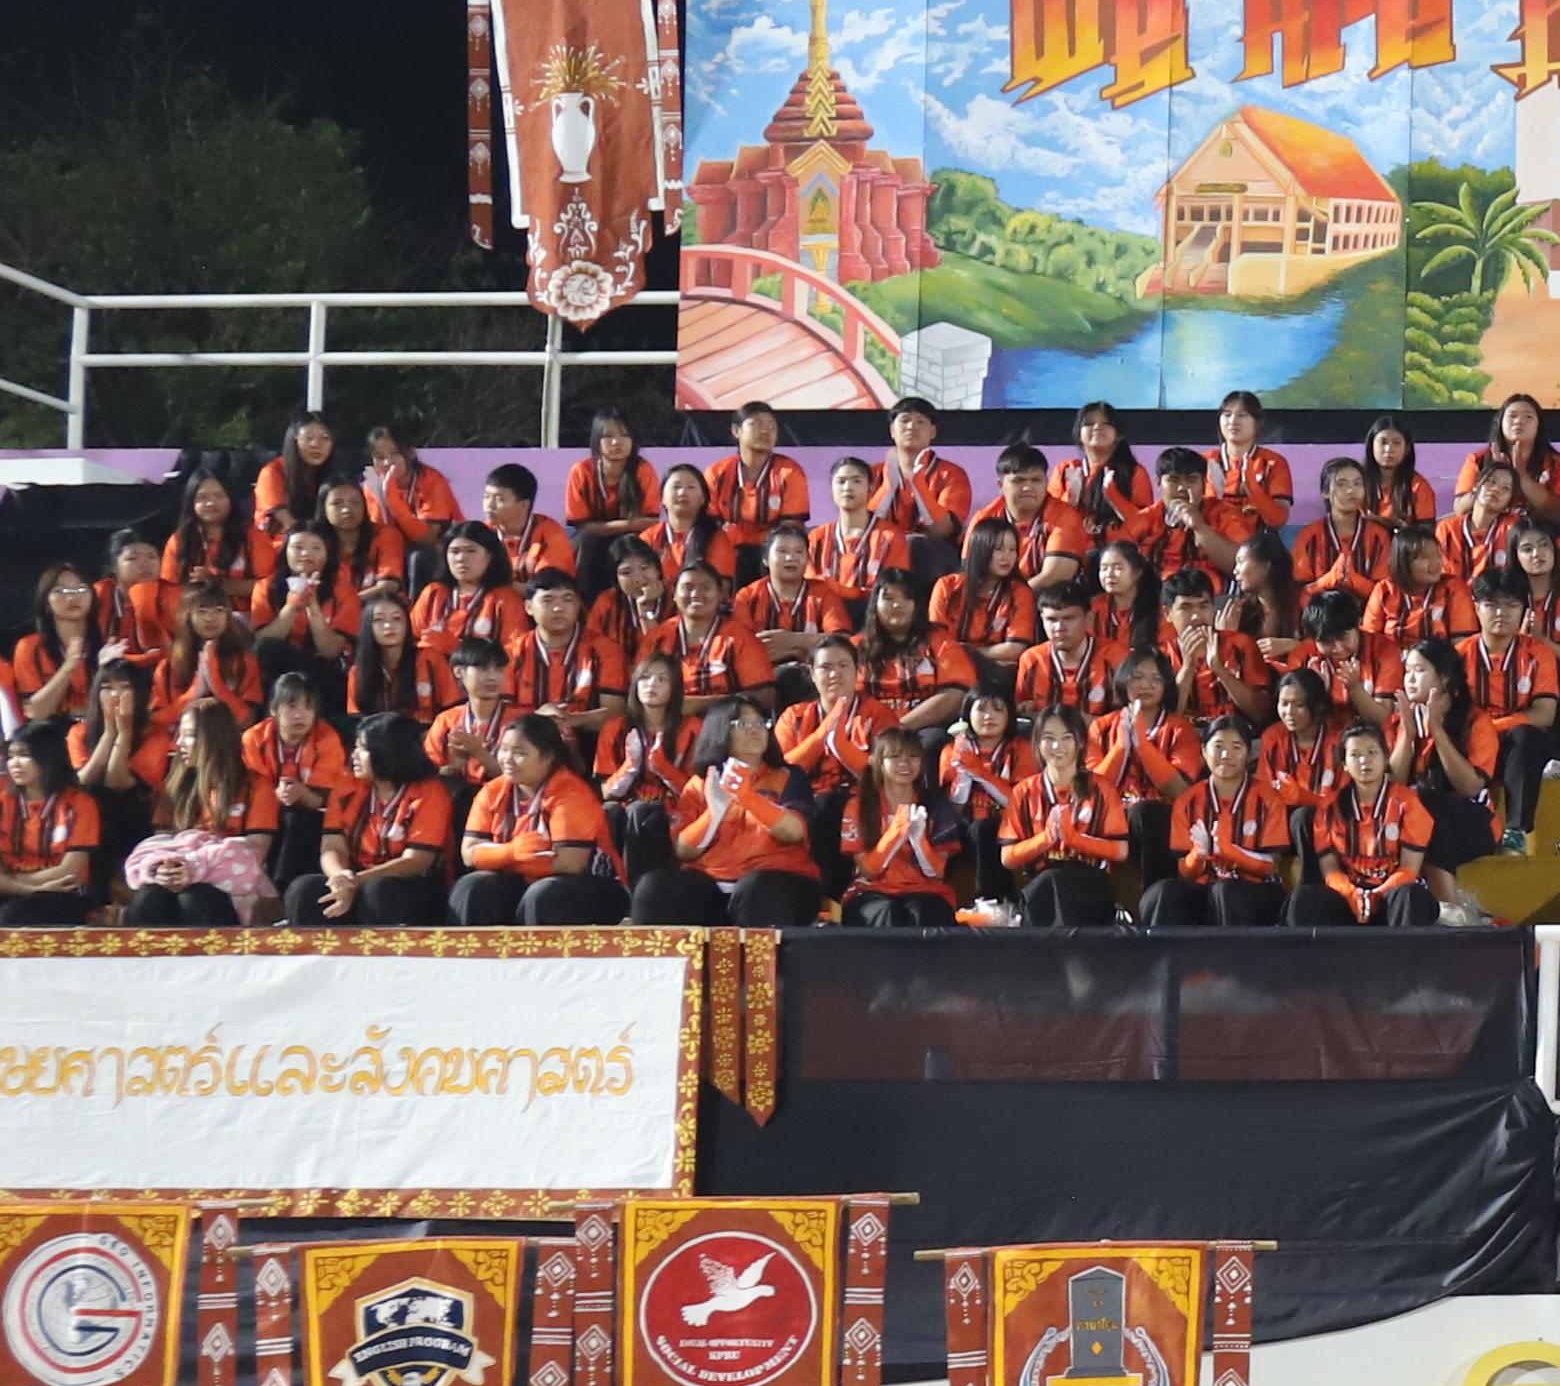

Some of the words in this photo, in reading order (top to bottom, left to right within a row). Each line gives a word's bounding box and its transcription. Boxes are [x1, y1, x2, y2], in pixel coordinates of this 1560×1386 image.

[409, 1336, 473, 1358] PROGRAM
[656, 1335, 697, 1376] SOCIAL
[698, 1334, 799, 1382] DEVELOPMENT
